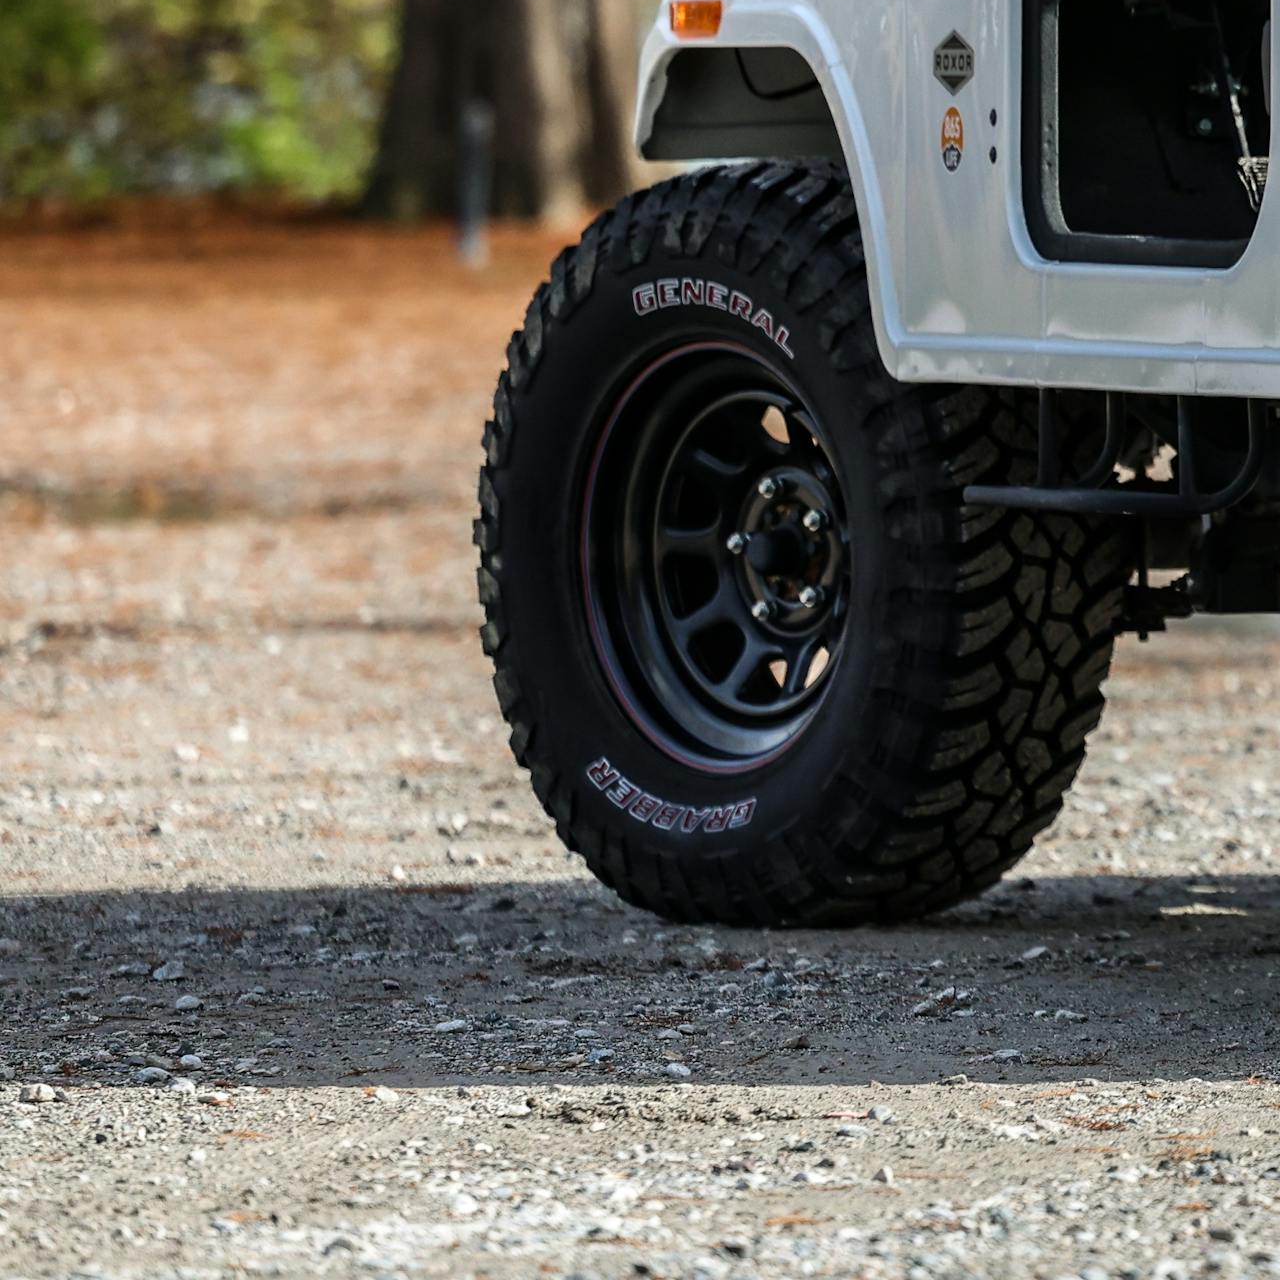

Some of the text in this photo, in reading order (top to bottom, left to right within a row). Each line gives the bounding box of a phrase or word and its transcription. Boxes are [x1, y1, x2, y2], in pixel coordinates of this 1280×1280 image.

[936, 54, 972, 71] ROXOR
[632, 277, 795, 360] GENERAL
[585, 756, 757, 833] GRABBER
